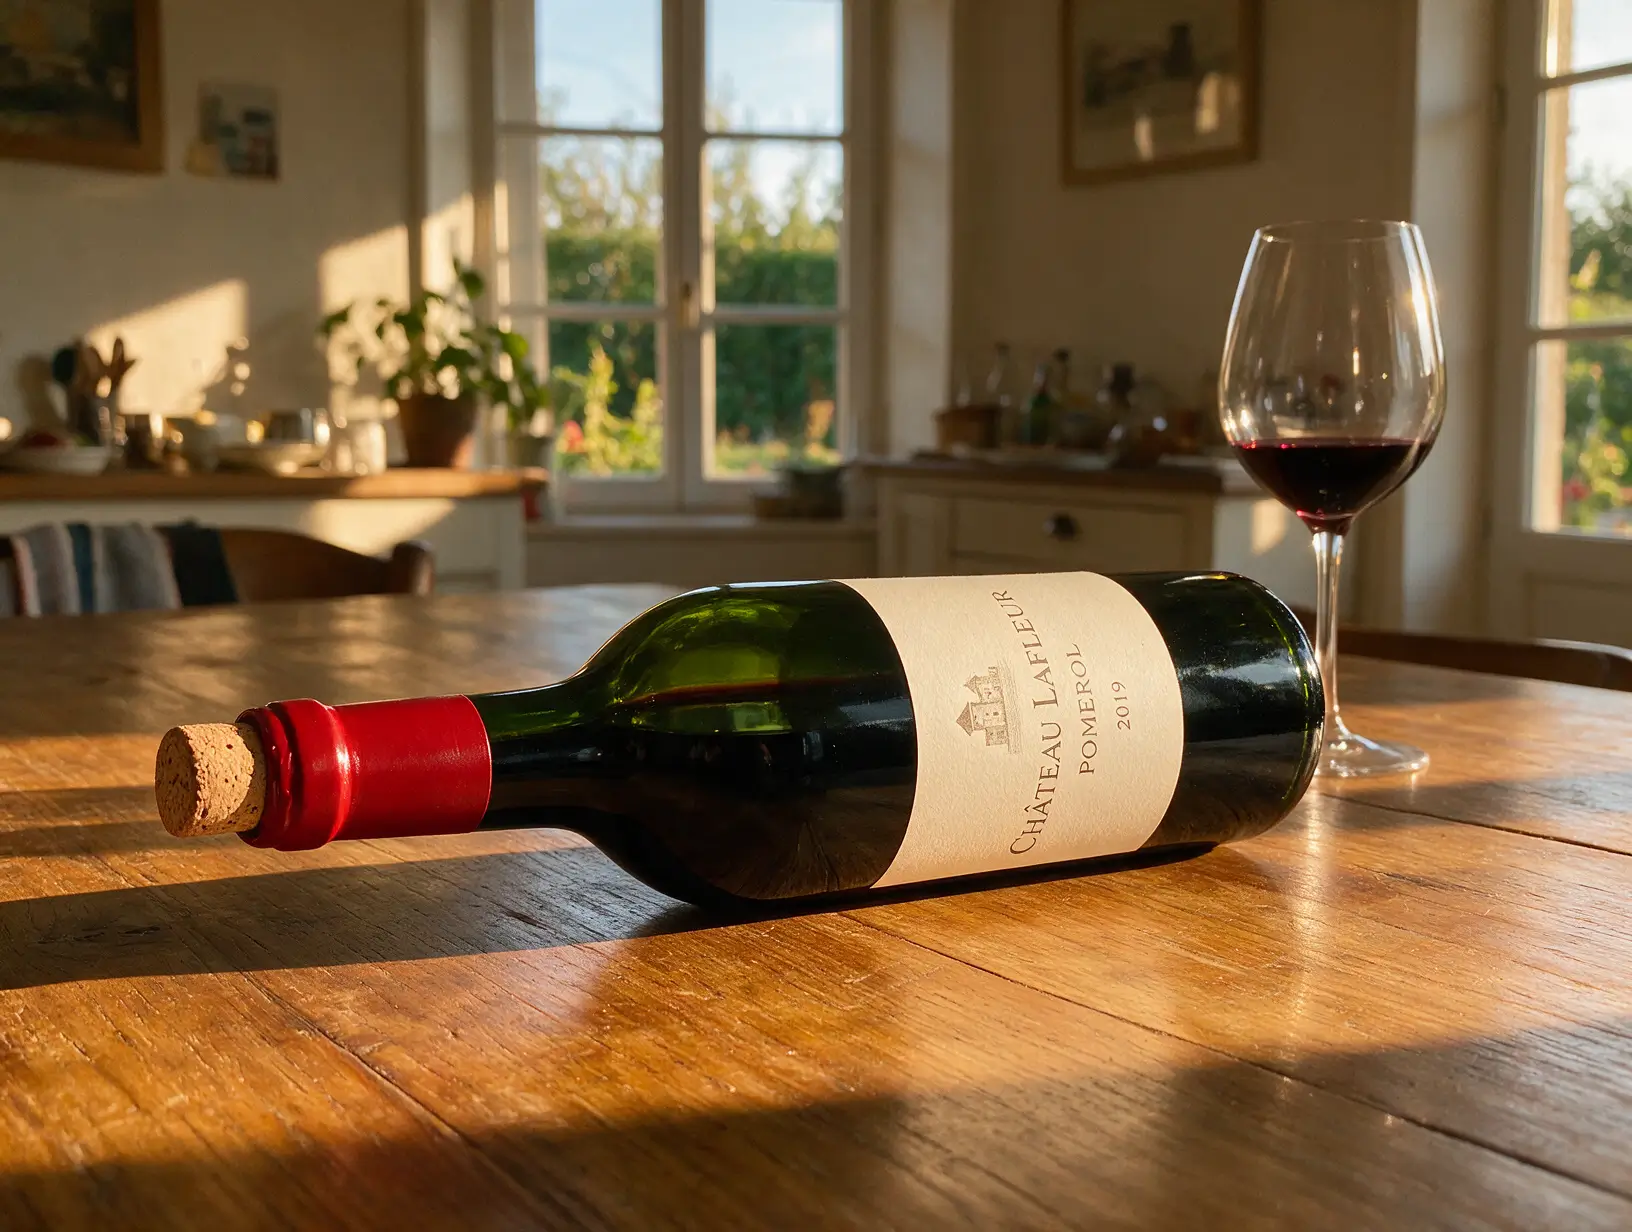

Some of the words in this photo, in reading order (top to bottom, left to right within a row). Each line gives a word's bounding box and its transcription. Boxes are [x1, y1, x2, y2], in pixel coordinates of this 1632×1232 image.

[991, 590, 1059, 709] LAFLEUR
[1066, 643, 1098, 775] POMEROL
[1111, 681, 1131, 730] 2019
[1009, 722, 1062, 855] CHÂTEAU
